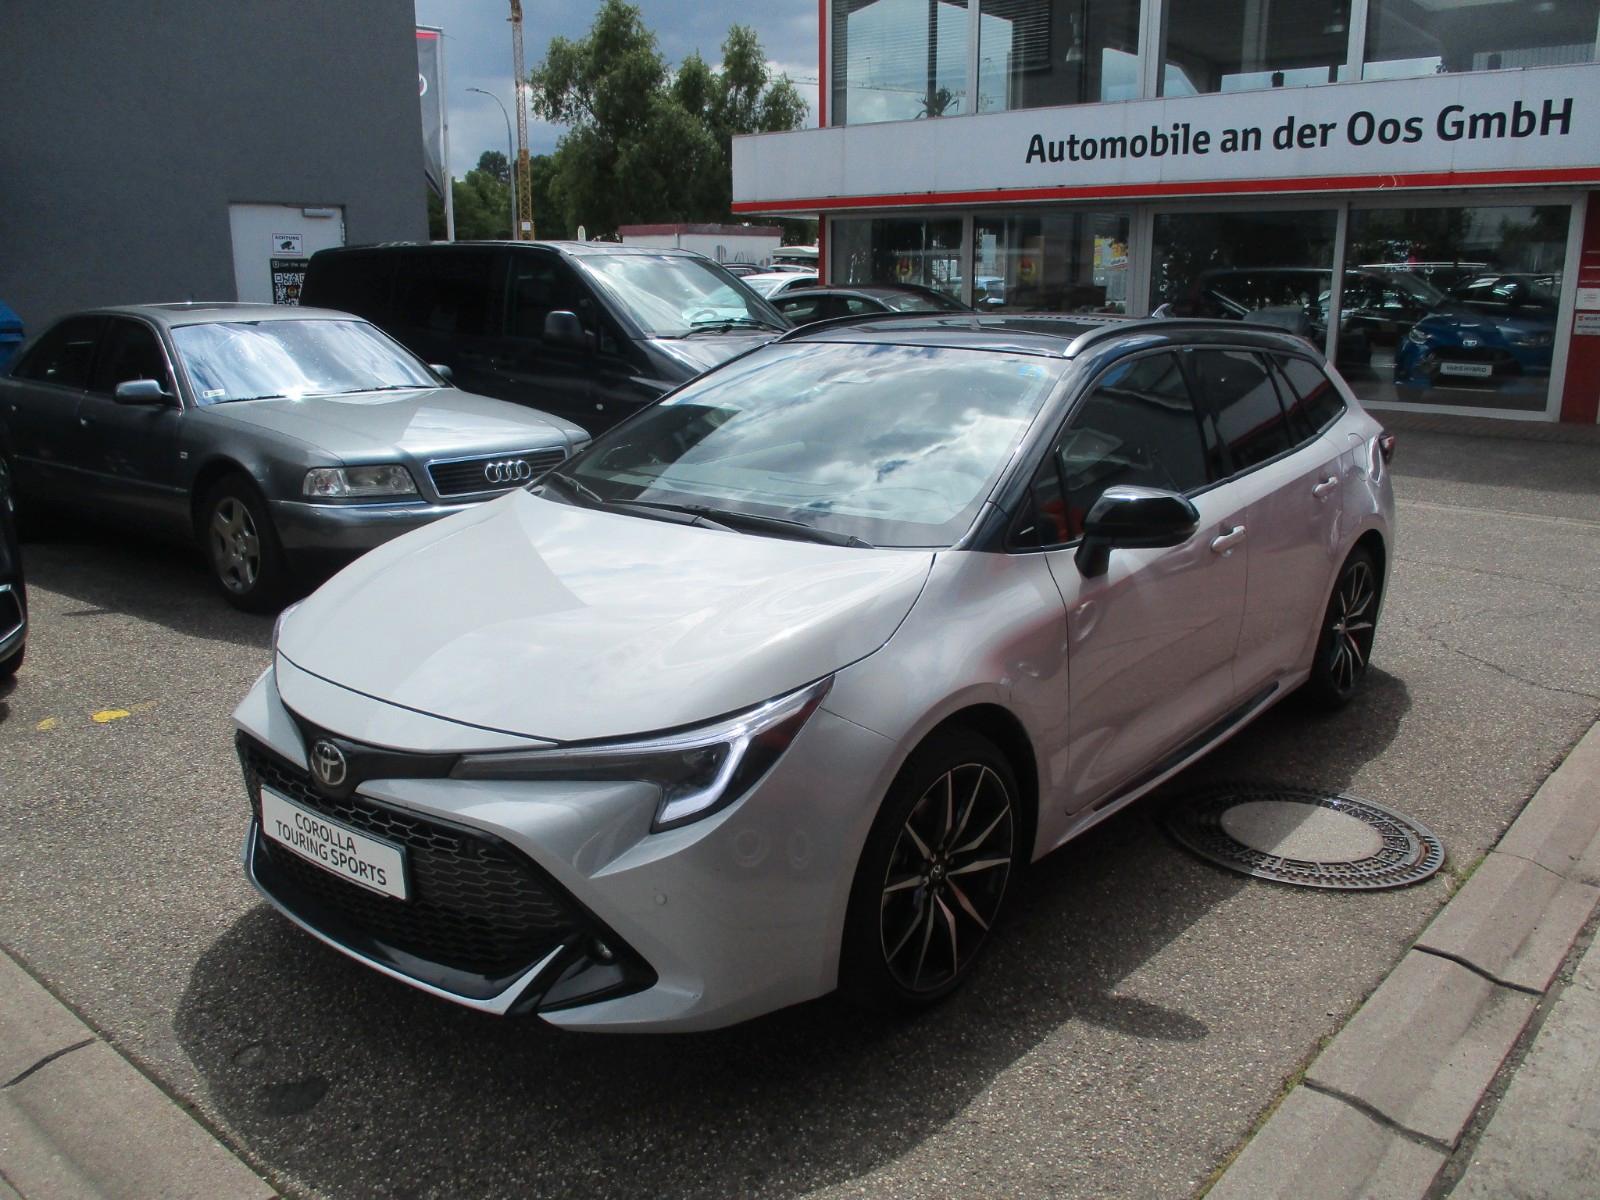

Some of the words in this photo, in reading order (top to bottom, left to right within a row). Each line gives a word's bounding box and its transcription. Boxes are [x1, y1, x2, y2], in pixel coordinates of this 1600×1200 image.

[1025, 122, 1210, 164] Automobile
[1220, 125, 1262, 153] an
[1273, 115, 1337, 149] der
[1346, 109, 1423, 146] Oos
[1437, 98, 1573, 142] GmbH
[276, 820, 328, 861] TOURING
[330, 850, 387, 886] SPORTS
[295, 812, 357, 854] COROLLA
